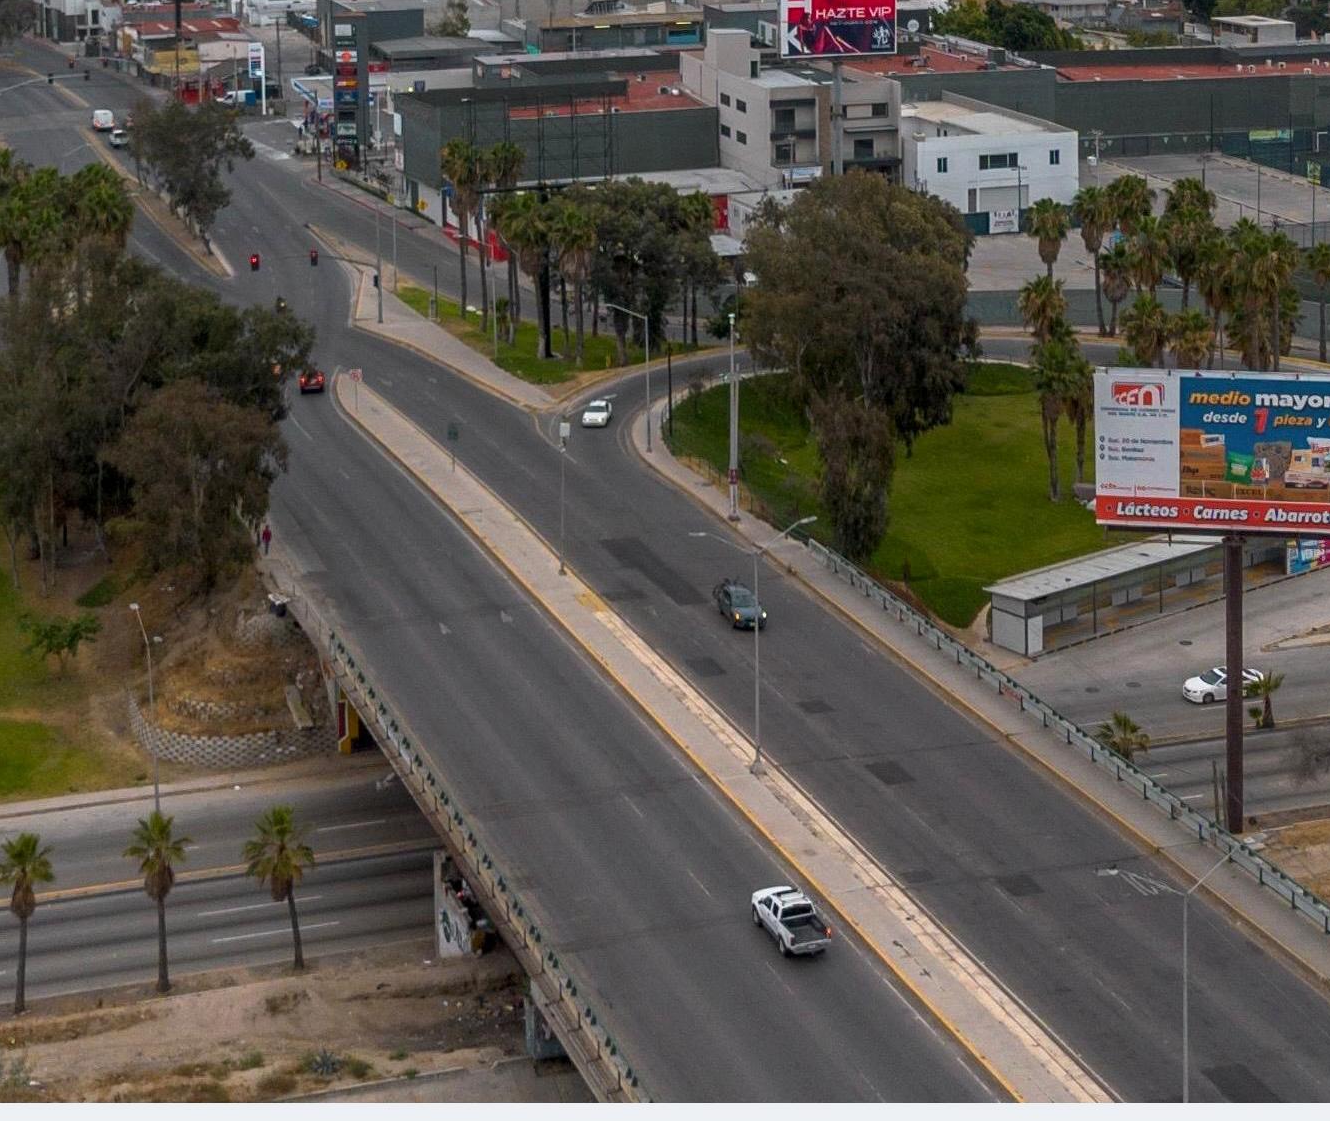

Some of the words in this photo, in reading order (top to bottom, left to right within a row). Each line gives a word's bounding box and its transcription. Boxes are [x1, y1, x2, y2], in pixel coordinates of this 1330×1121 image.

[815, 7, 866, 19] HAZTE
[868, 6, 892, 17] VIP
[1189, 390, 1251, 406] medio
[1202, 411, 1248, 424] desde
[1254, 408, 1269, 433] 1
[1274, 414, 1312, 427] pieza
[1316, 417, 1325, 428] y
[1116, 500, 1178, 518] Lácteos
[1193, 504, 1248, 521] Carnes
